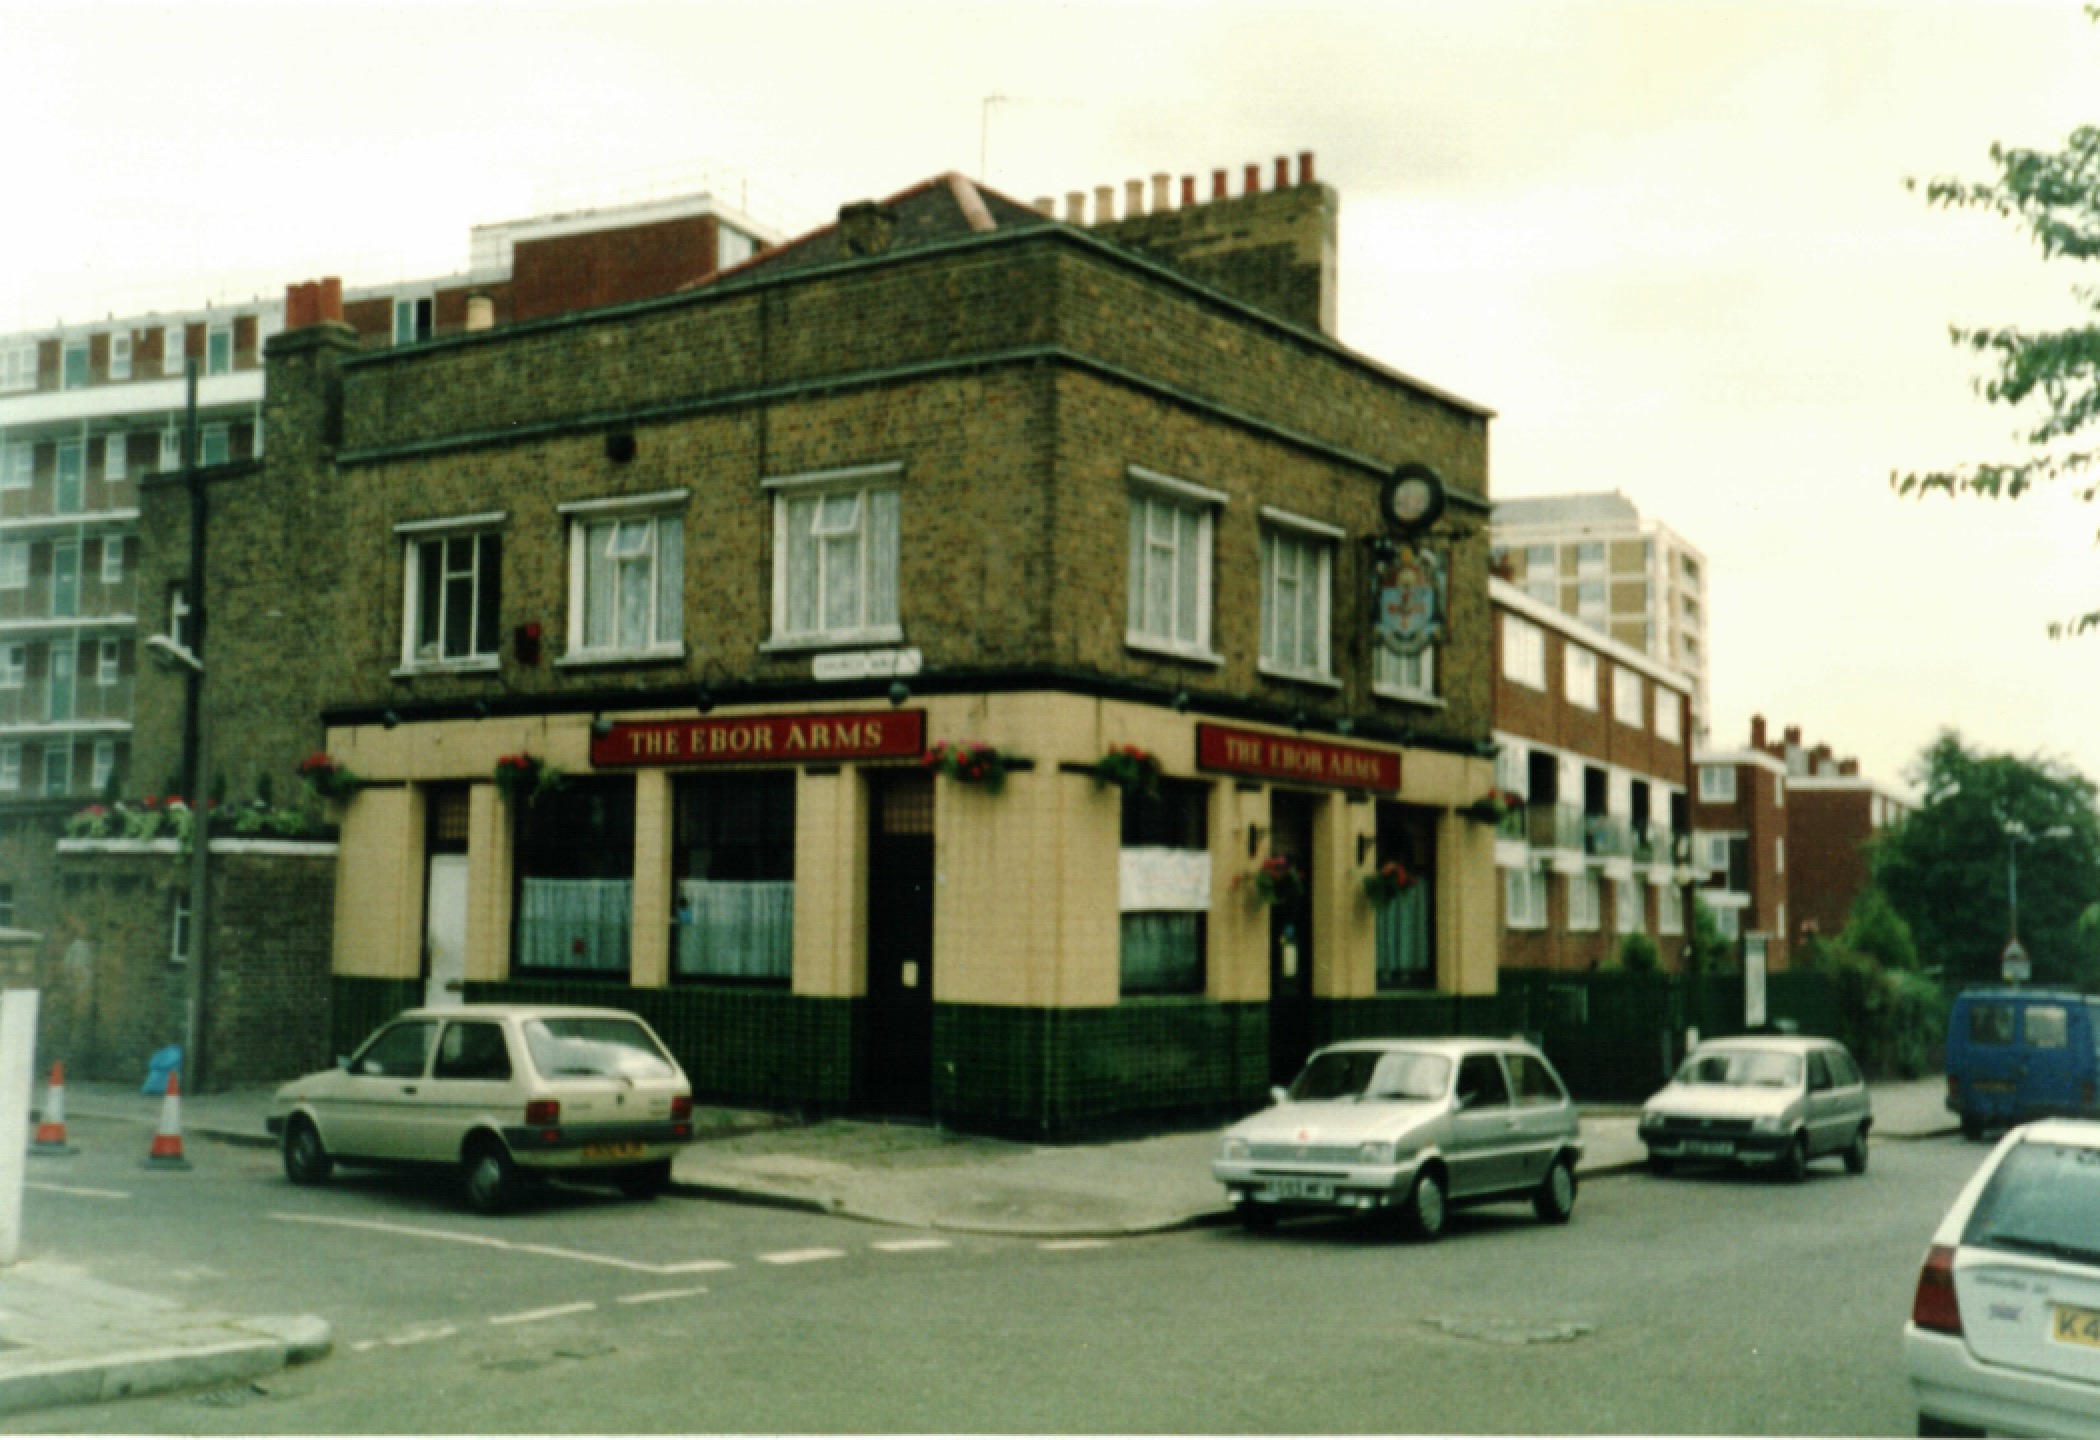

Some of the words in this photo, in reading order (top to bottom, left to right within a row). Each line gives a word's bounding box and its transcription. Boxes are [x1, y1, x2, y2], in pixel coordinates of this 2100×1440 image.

[628, 728, 680, 755] THE
[691, 724, 773, 753] EBOR
[785, 721, 883, 751] ARMS
[1226, 737, 1261, 765] THE
[1270, 743, 1323, 773] EBOR
[1331, 752, 1380, 781] ARMS
